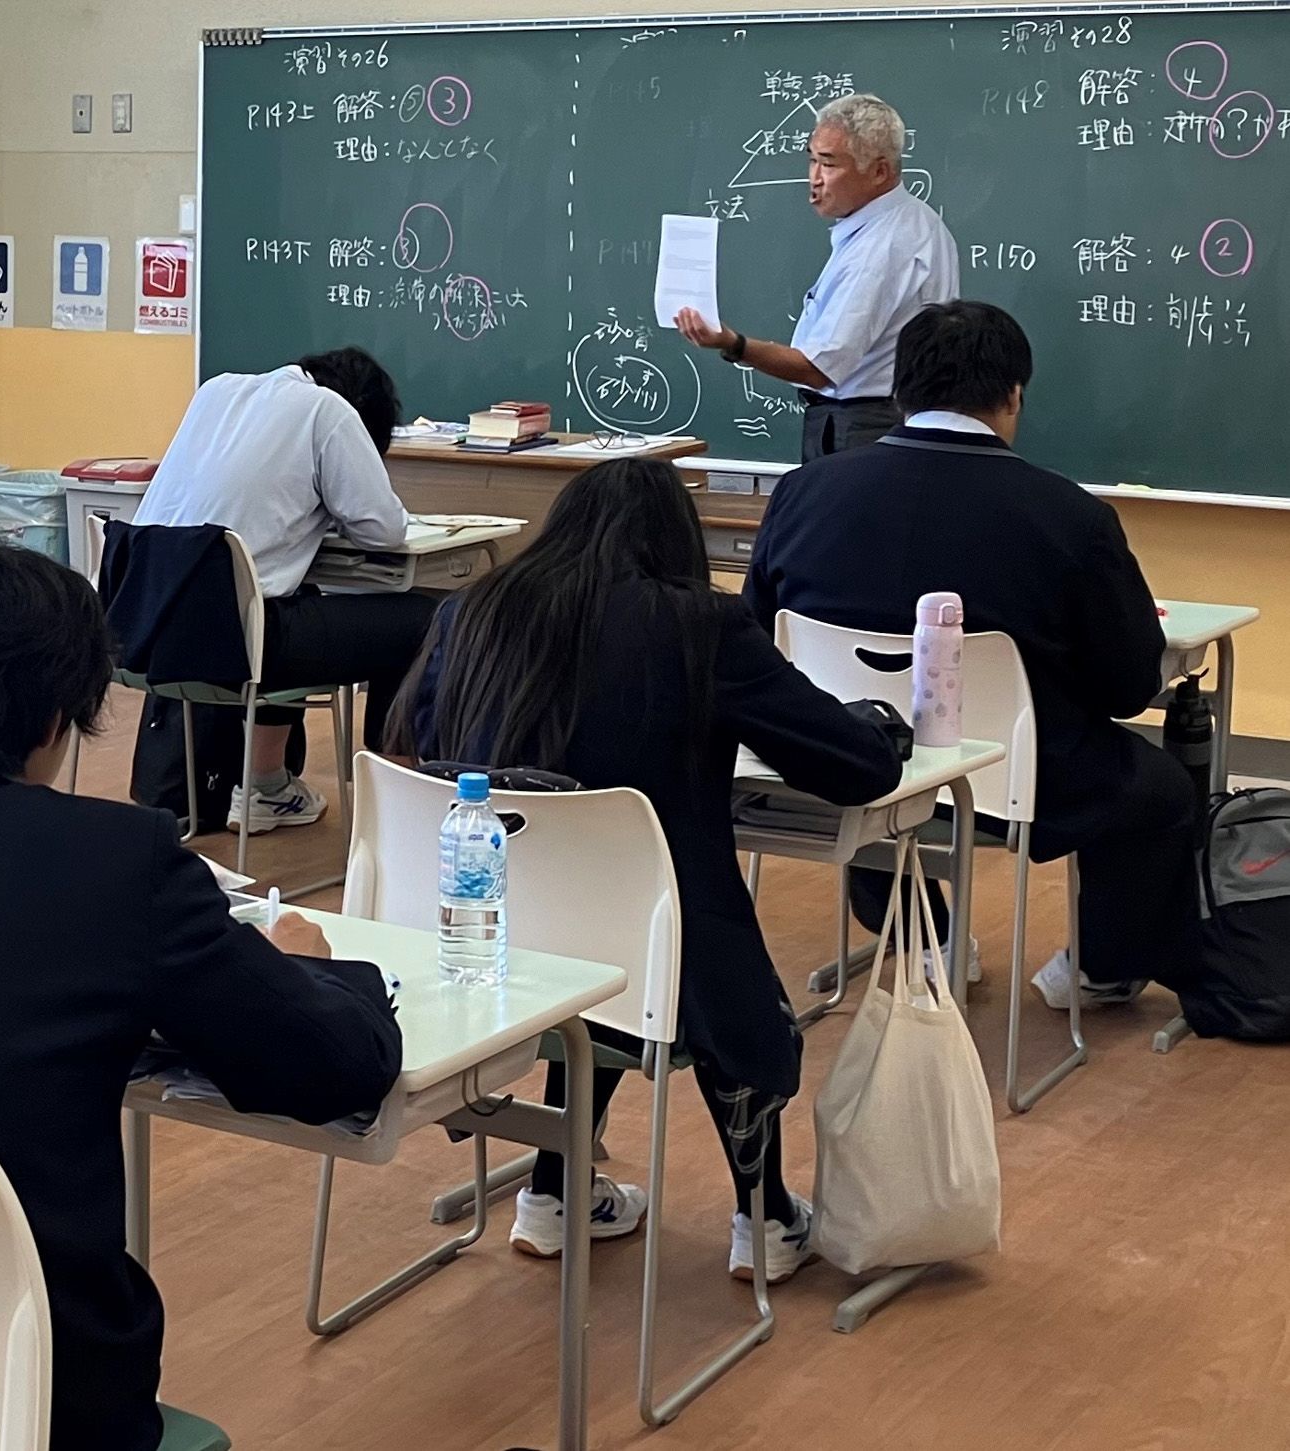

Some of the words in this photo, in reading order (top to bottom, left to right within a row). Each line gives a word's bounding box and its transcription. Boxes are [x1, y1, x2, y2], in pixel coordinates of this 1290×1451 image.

[139, 305, 188, 319] 燃えるゴミ
